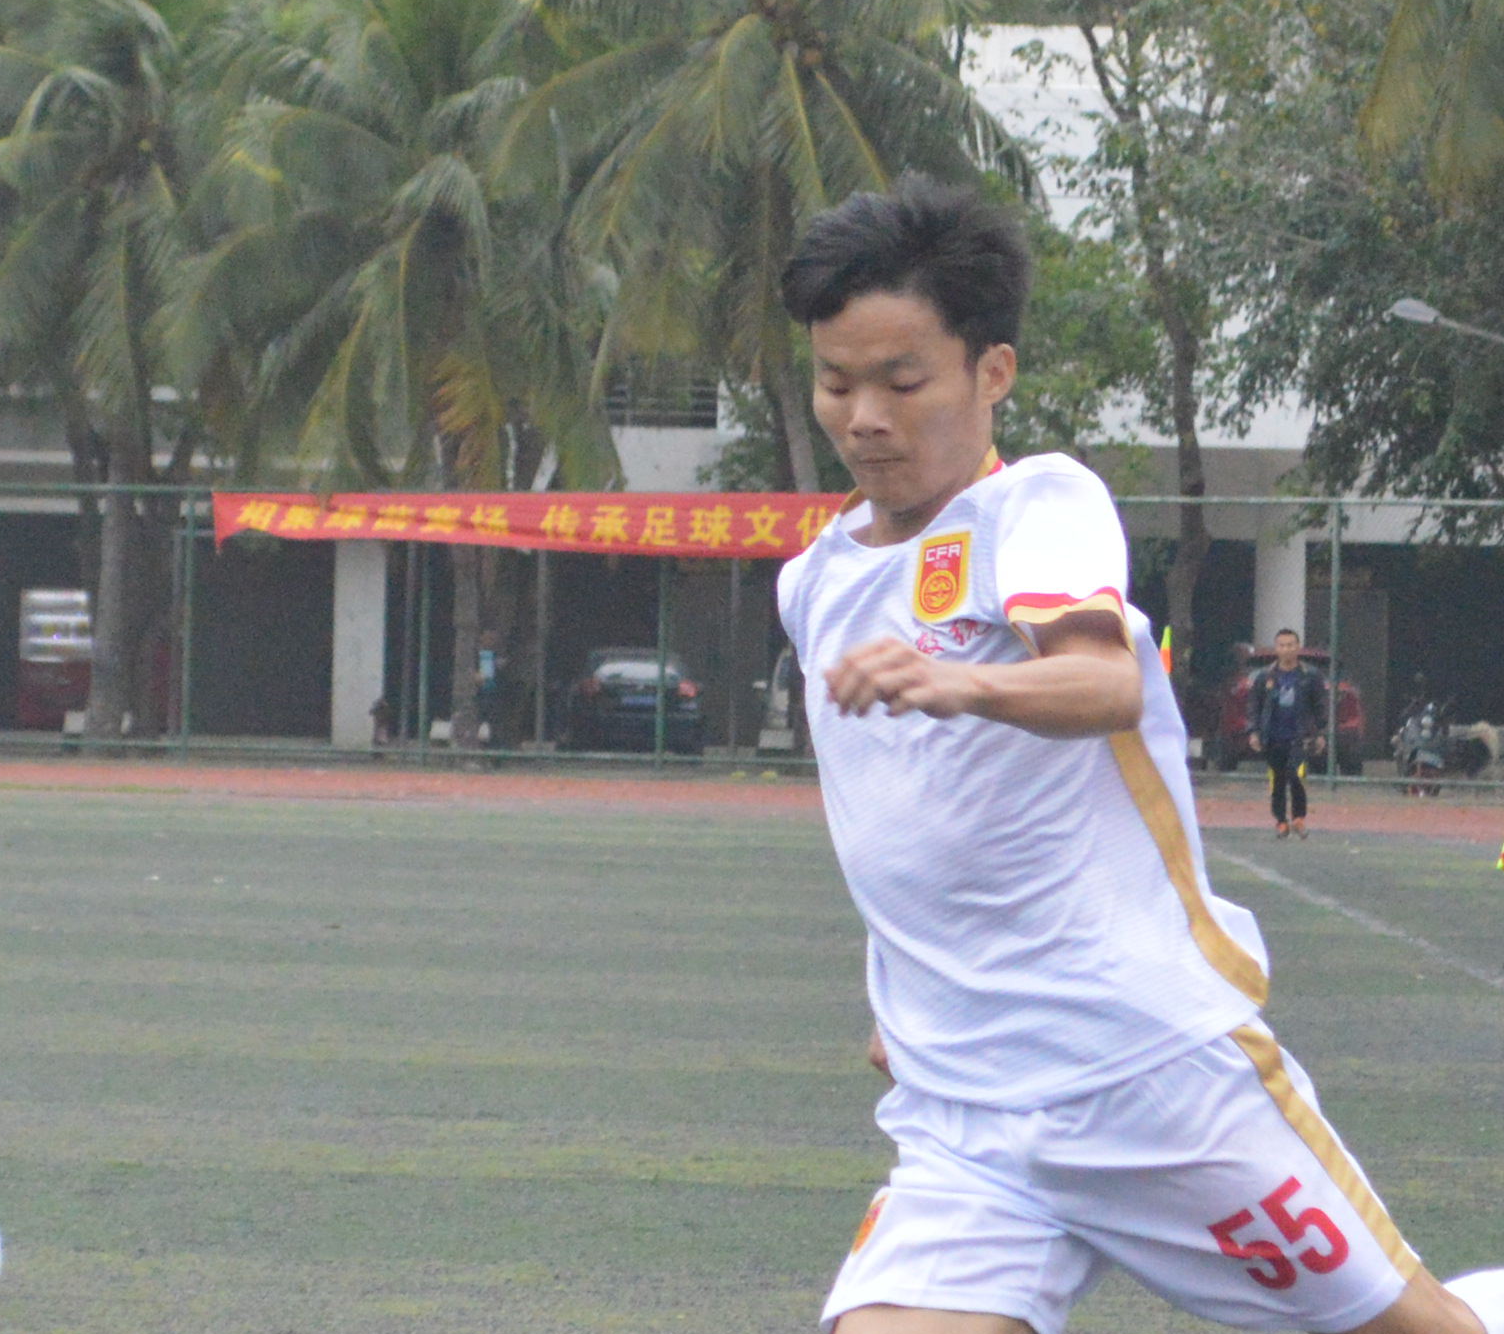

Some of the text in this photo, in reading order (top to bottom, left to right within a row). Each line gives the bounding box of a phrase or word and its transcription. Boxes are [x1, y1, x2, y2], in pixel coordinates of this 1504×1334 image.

[539, 504, 839, 548] 传承足球文化
[924, 543, 962, 563] CFA
[1206, 1175, 1349, 1291] 55
